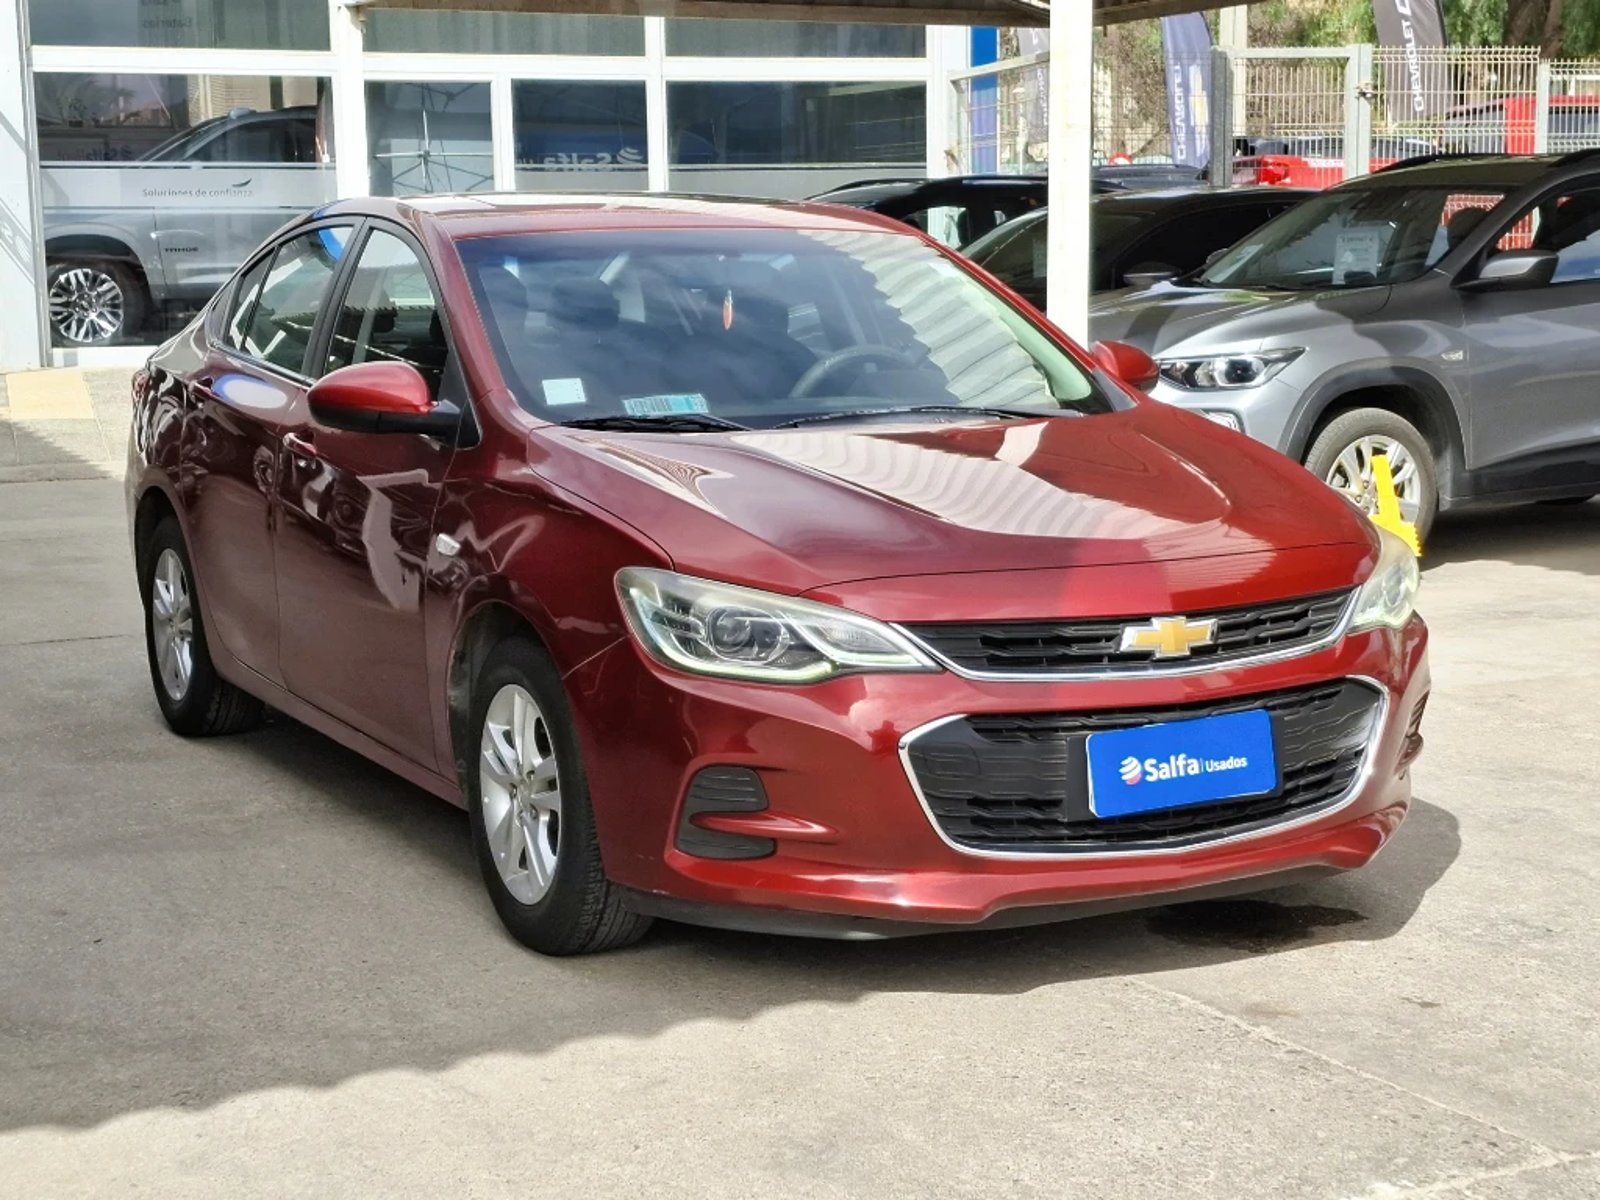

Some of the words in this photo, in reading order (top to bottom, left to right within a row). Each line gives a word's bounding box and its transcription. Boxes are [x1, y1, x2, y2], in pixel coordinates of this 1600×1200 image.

[1401, 19, 1425, 112] CHEVROLET
[195, 187, 207, 198] de
[1144, 753, 1200, 782] Salfa
[1205, 755, 1248, 773] Usados
